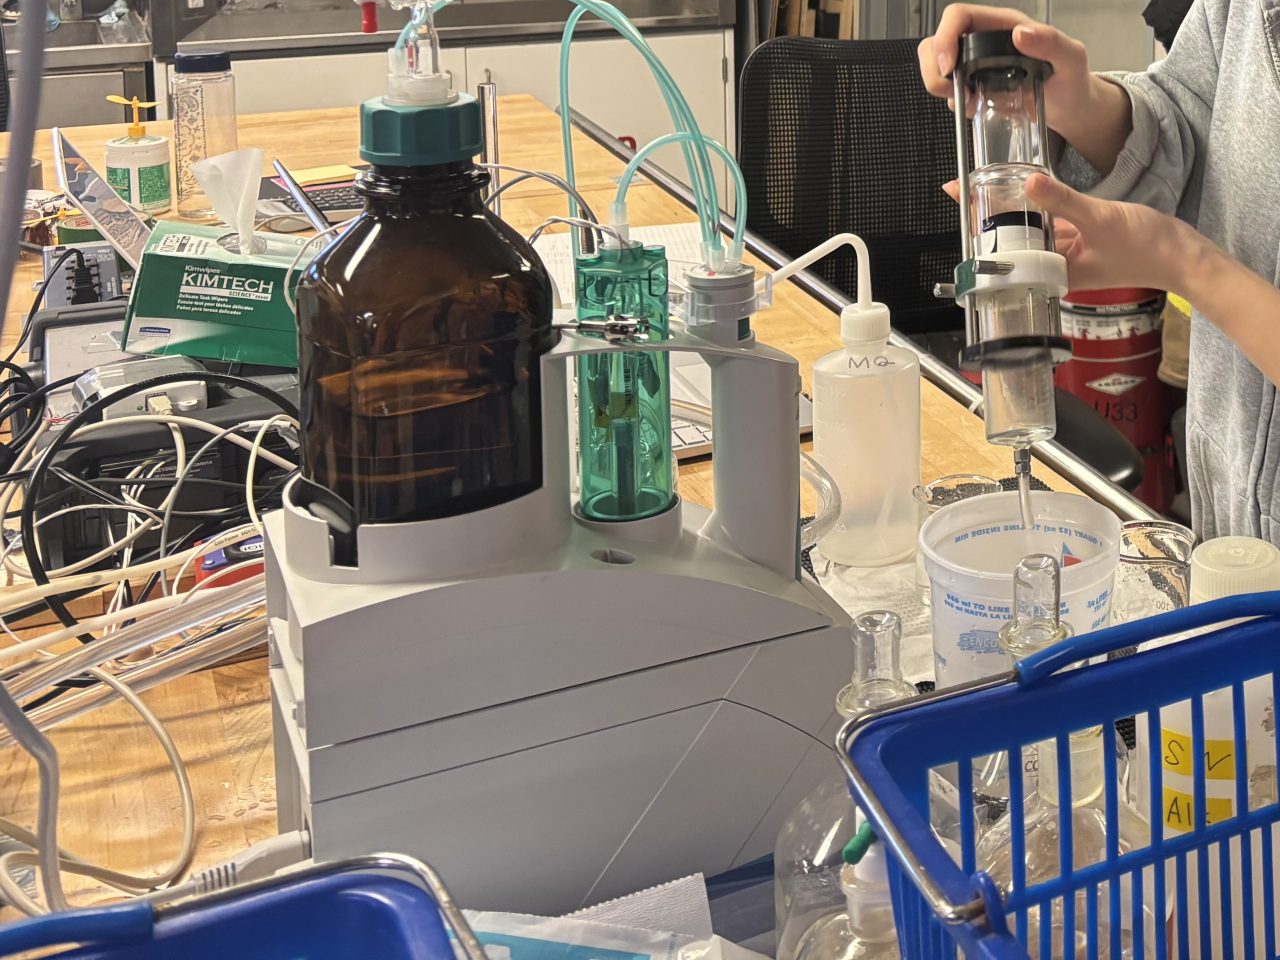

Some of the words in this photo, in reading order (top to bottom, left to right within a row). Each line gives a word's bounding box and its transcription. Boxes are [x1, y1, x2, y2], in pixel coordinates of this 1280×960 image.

[184, 265, 221, 274] Kimwipes
[181, 272, 274, 294] KIMTECH
[964, 608, 988, 617] HASTA
[973, 602, 986, 610] TO
[988, 605, 1010, 613] LINE
